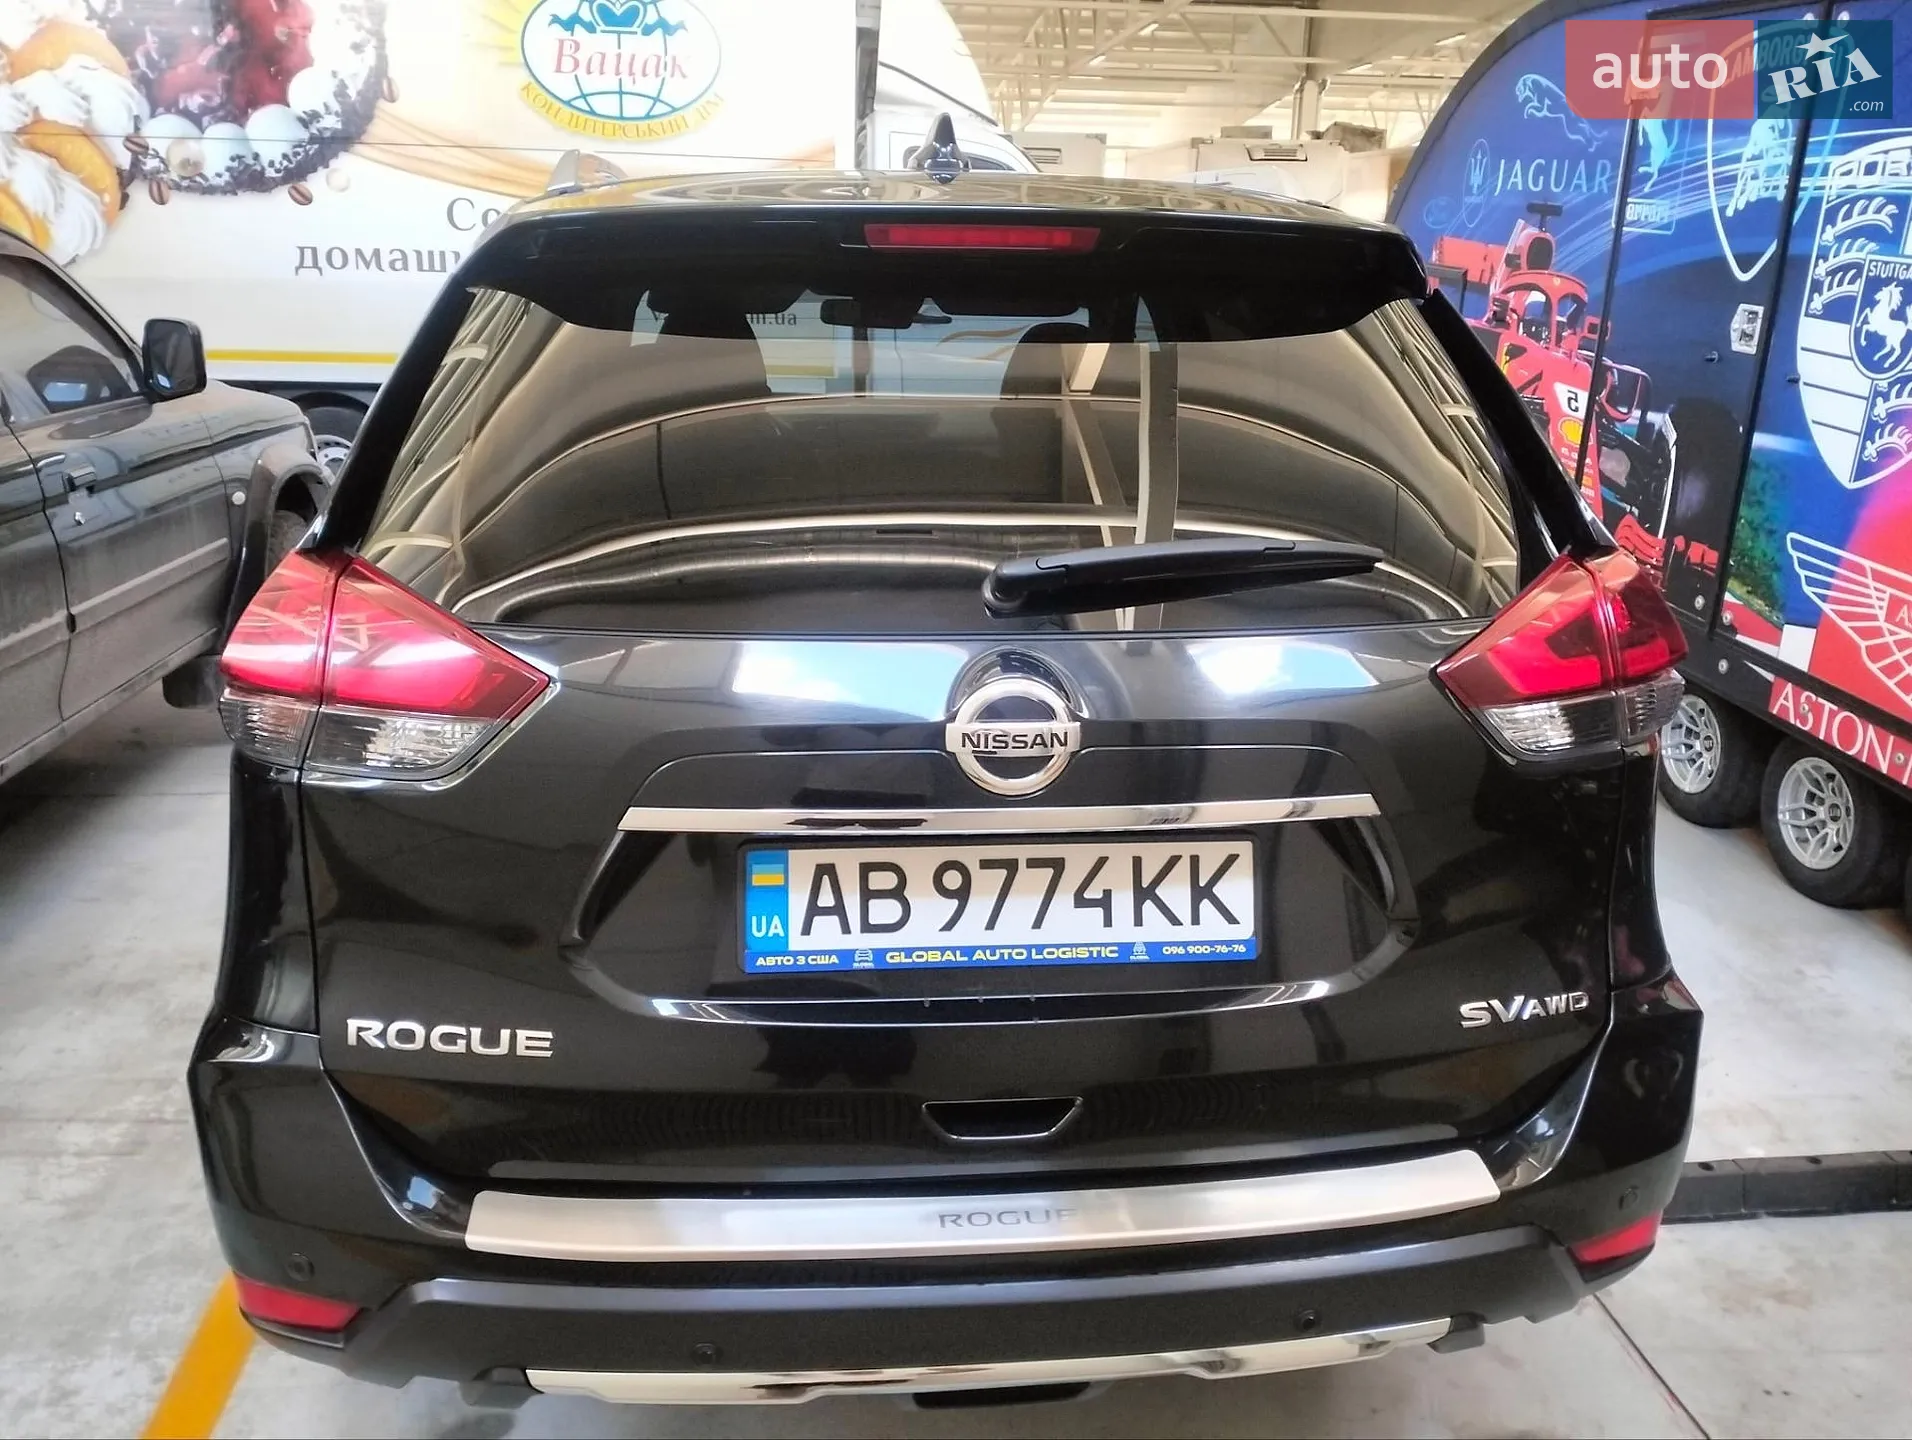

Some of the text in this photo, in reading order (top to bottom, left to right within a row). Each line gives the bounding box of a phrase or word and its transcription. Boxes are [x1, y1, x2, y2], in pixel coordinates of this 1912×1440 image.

[552, 38, 689, 86] Вацак
[1494, 158, 1612, 196] JAGUAR
[961, 729, 1069, 750] NISSAN
[1772, 682, 1895, 775] ASTON
[801, 853, 1241, 937] AB 9774 KK
[751, 916, 785, 937] UA
[755, 956, 791, 966] АВТО
[809, 955, 839, 965] США
[885, 949, 968, 963] GLOBAL
[973, 948, 1027, 961] AUTO
[1032, 946, 1119, 960] LOGISTIC
[1162, 944, 1247, 955] 096 900-76-76
[1459, 992, 1590, 1028] SV AWD
[347, 1018, 554, 1057] ROGUE
